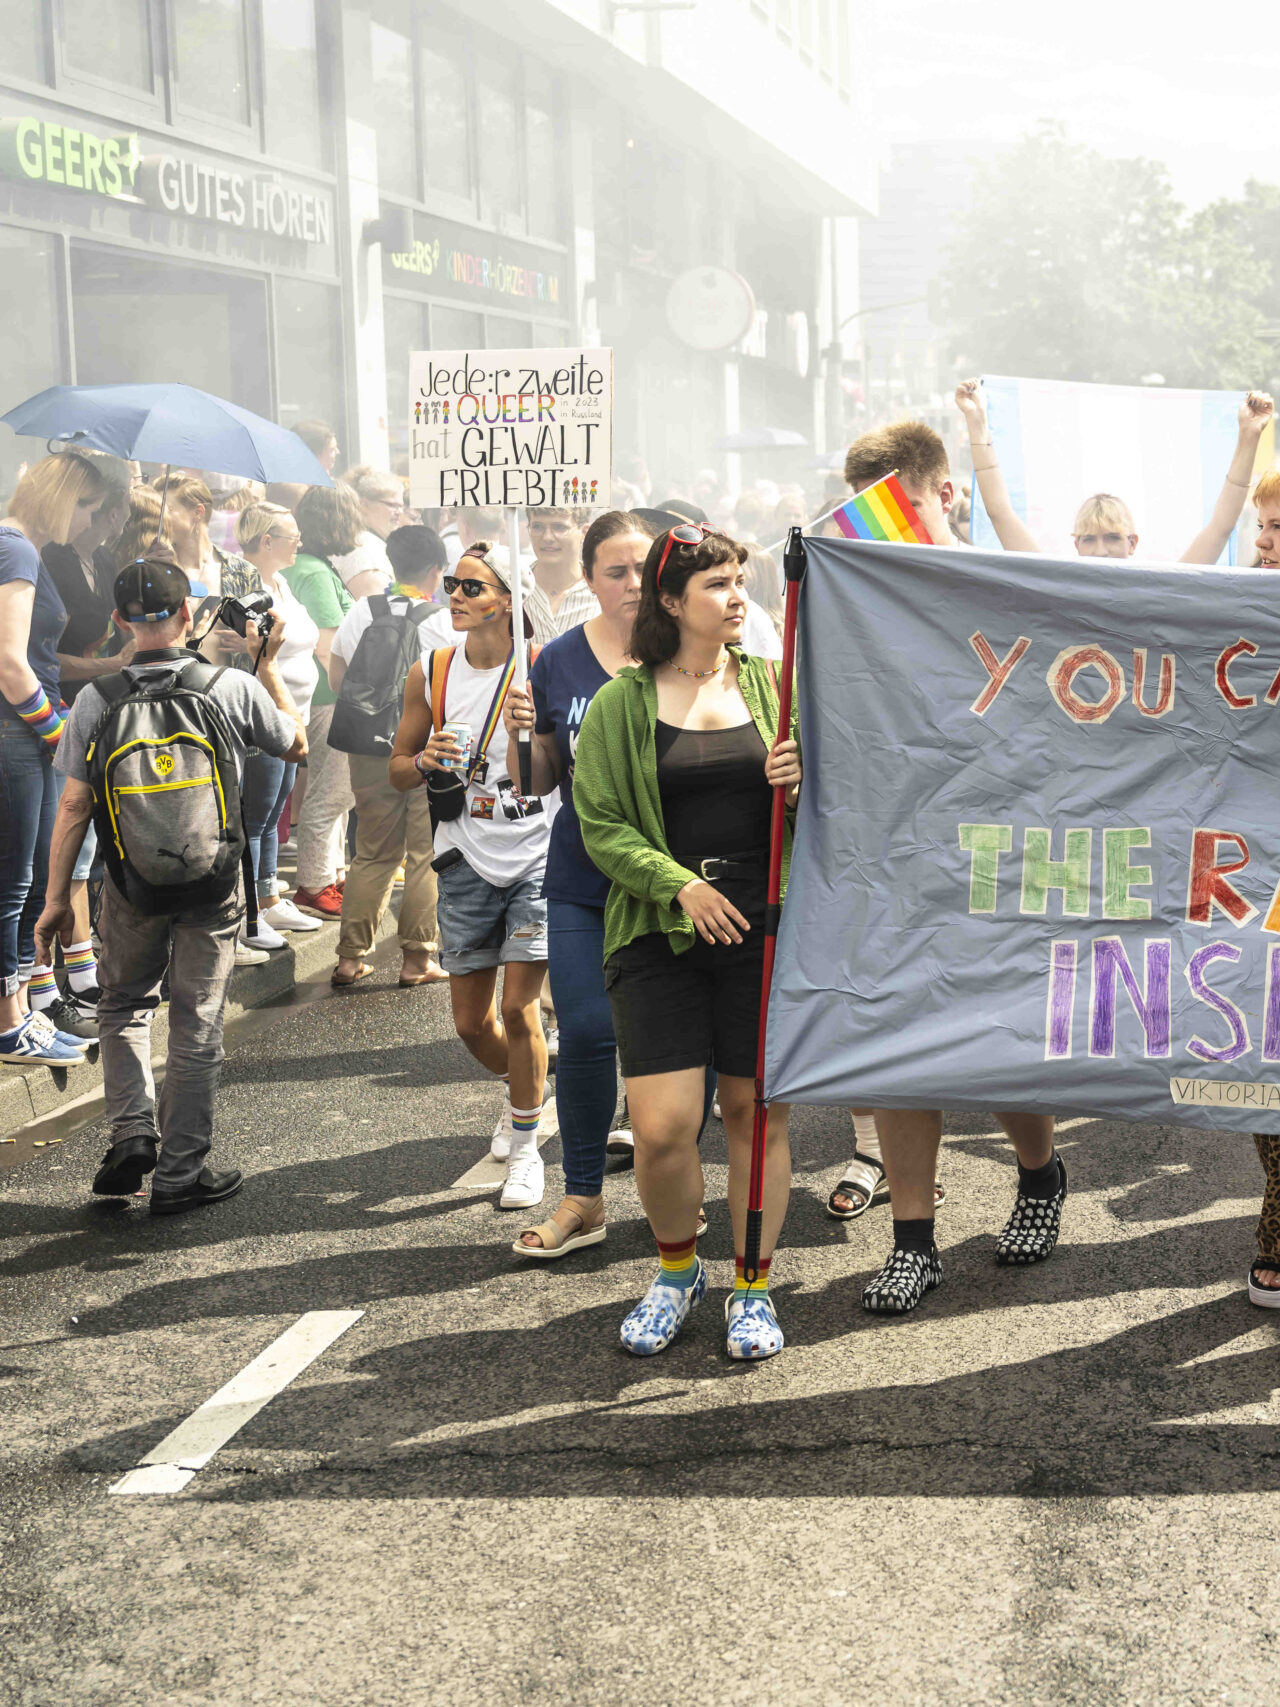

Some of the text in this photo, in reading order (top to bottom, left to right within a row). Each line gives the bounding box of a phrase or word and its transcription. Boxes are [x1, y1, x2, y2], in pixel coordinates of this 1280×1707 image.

[16, 116, 330, 245] GEERS GUTES HÖREN
[420, 353, 603, 397] Jede:r zweite
[457, 394, 556, 425] QUEER
[571, 409, 602, 419] Russland
[575, 397, 599, 407] 2023
[413, 424, 599, 467] hat GEWALT
[440, 469, 564, 507] ERLEBT
[968, 630, 1176, 725] YOU
[156, 757, 172, 769] BVB
[958, 824, 1153, 920] THE
